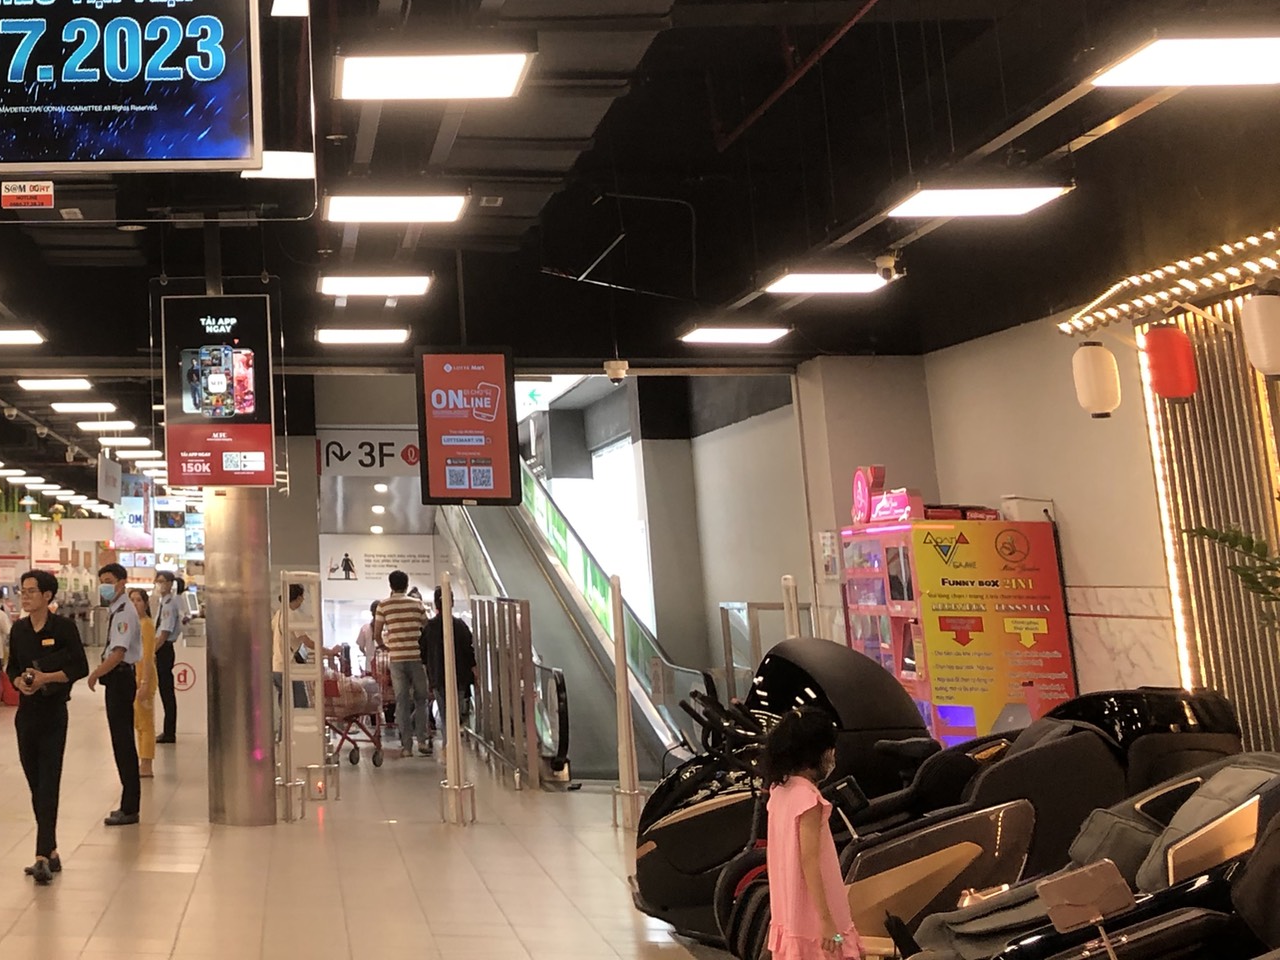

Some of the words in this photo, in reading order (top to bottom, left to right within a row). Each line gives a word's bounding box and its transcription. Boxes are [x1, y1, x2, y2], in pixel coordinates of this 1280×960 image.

[200, 315, 217, 326] TẢI
[217, 317, 238, 326] APP
[205, 325, 233, 333] NGAY
[358, 441, 395, 468] 3F
[181, 462, 211, 472] 150K
